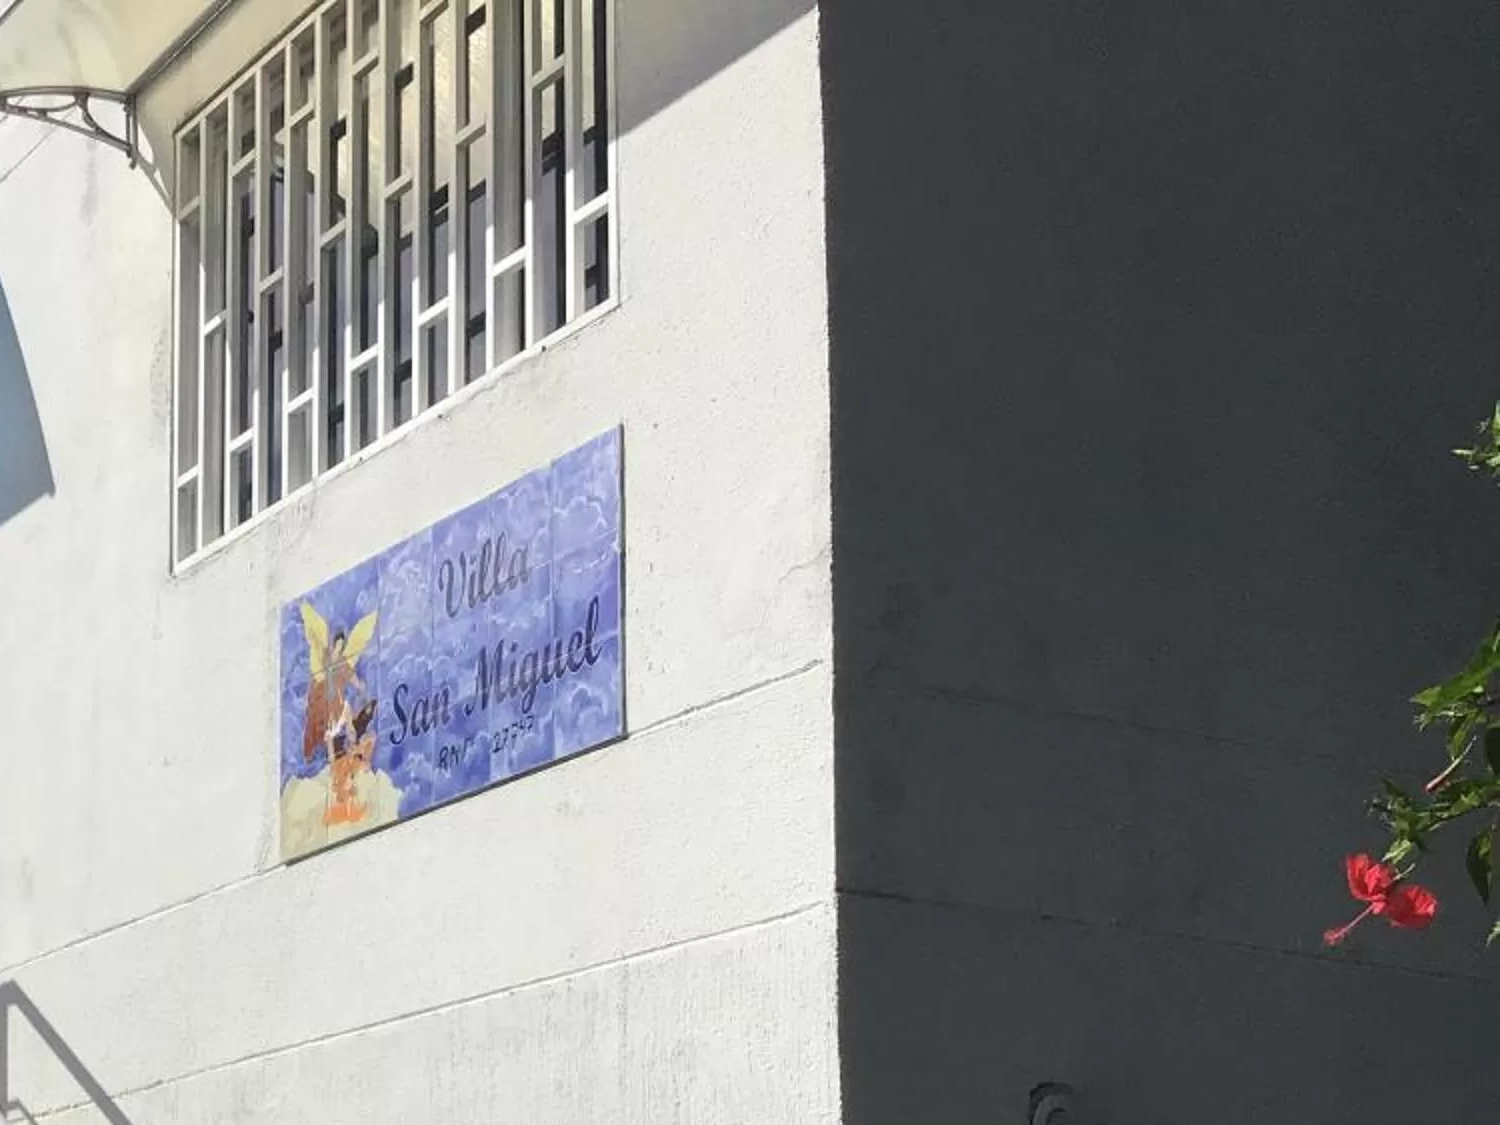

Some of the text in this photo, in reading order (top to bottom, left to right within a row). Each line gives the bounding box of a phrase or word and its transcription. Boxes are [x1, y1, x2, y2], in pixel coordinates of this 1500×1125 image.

[438, 531, 530, 618] Villa
[390, 595, 603, 745] San Miguel
